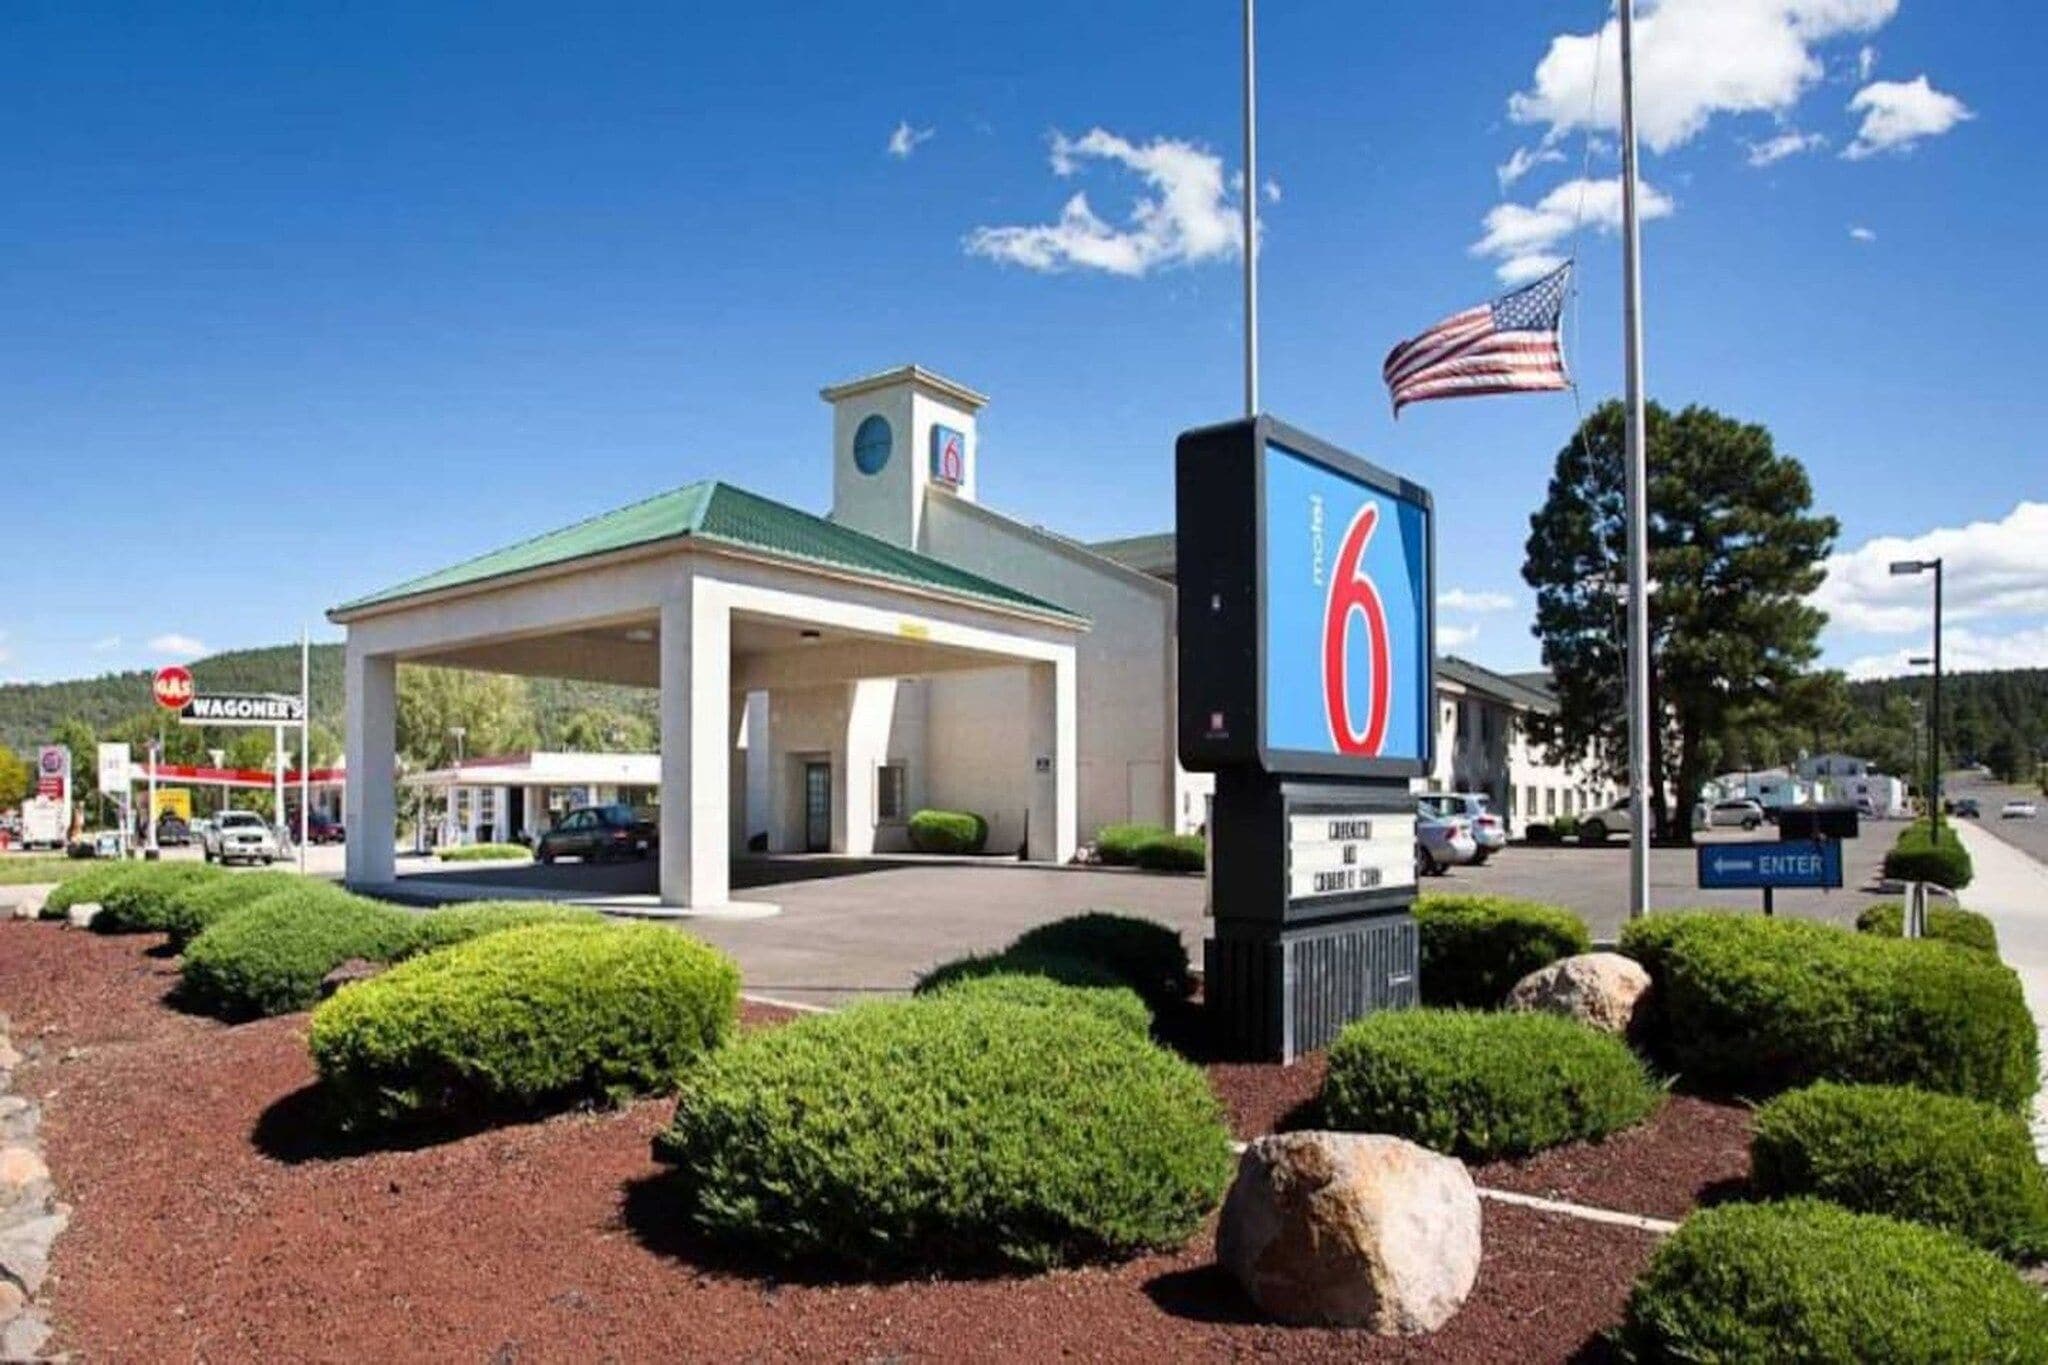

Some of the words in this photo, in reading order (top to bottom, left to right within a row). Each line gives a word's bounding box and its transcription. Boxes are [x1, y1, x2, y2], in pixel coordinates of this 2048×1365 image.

[944, 436, 960, 486] 6
[1309, 493, 1324, 586] motel
[1322, 501, 1392, 757] 6
[1759, 855, 1822, 875] ENTER
